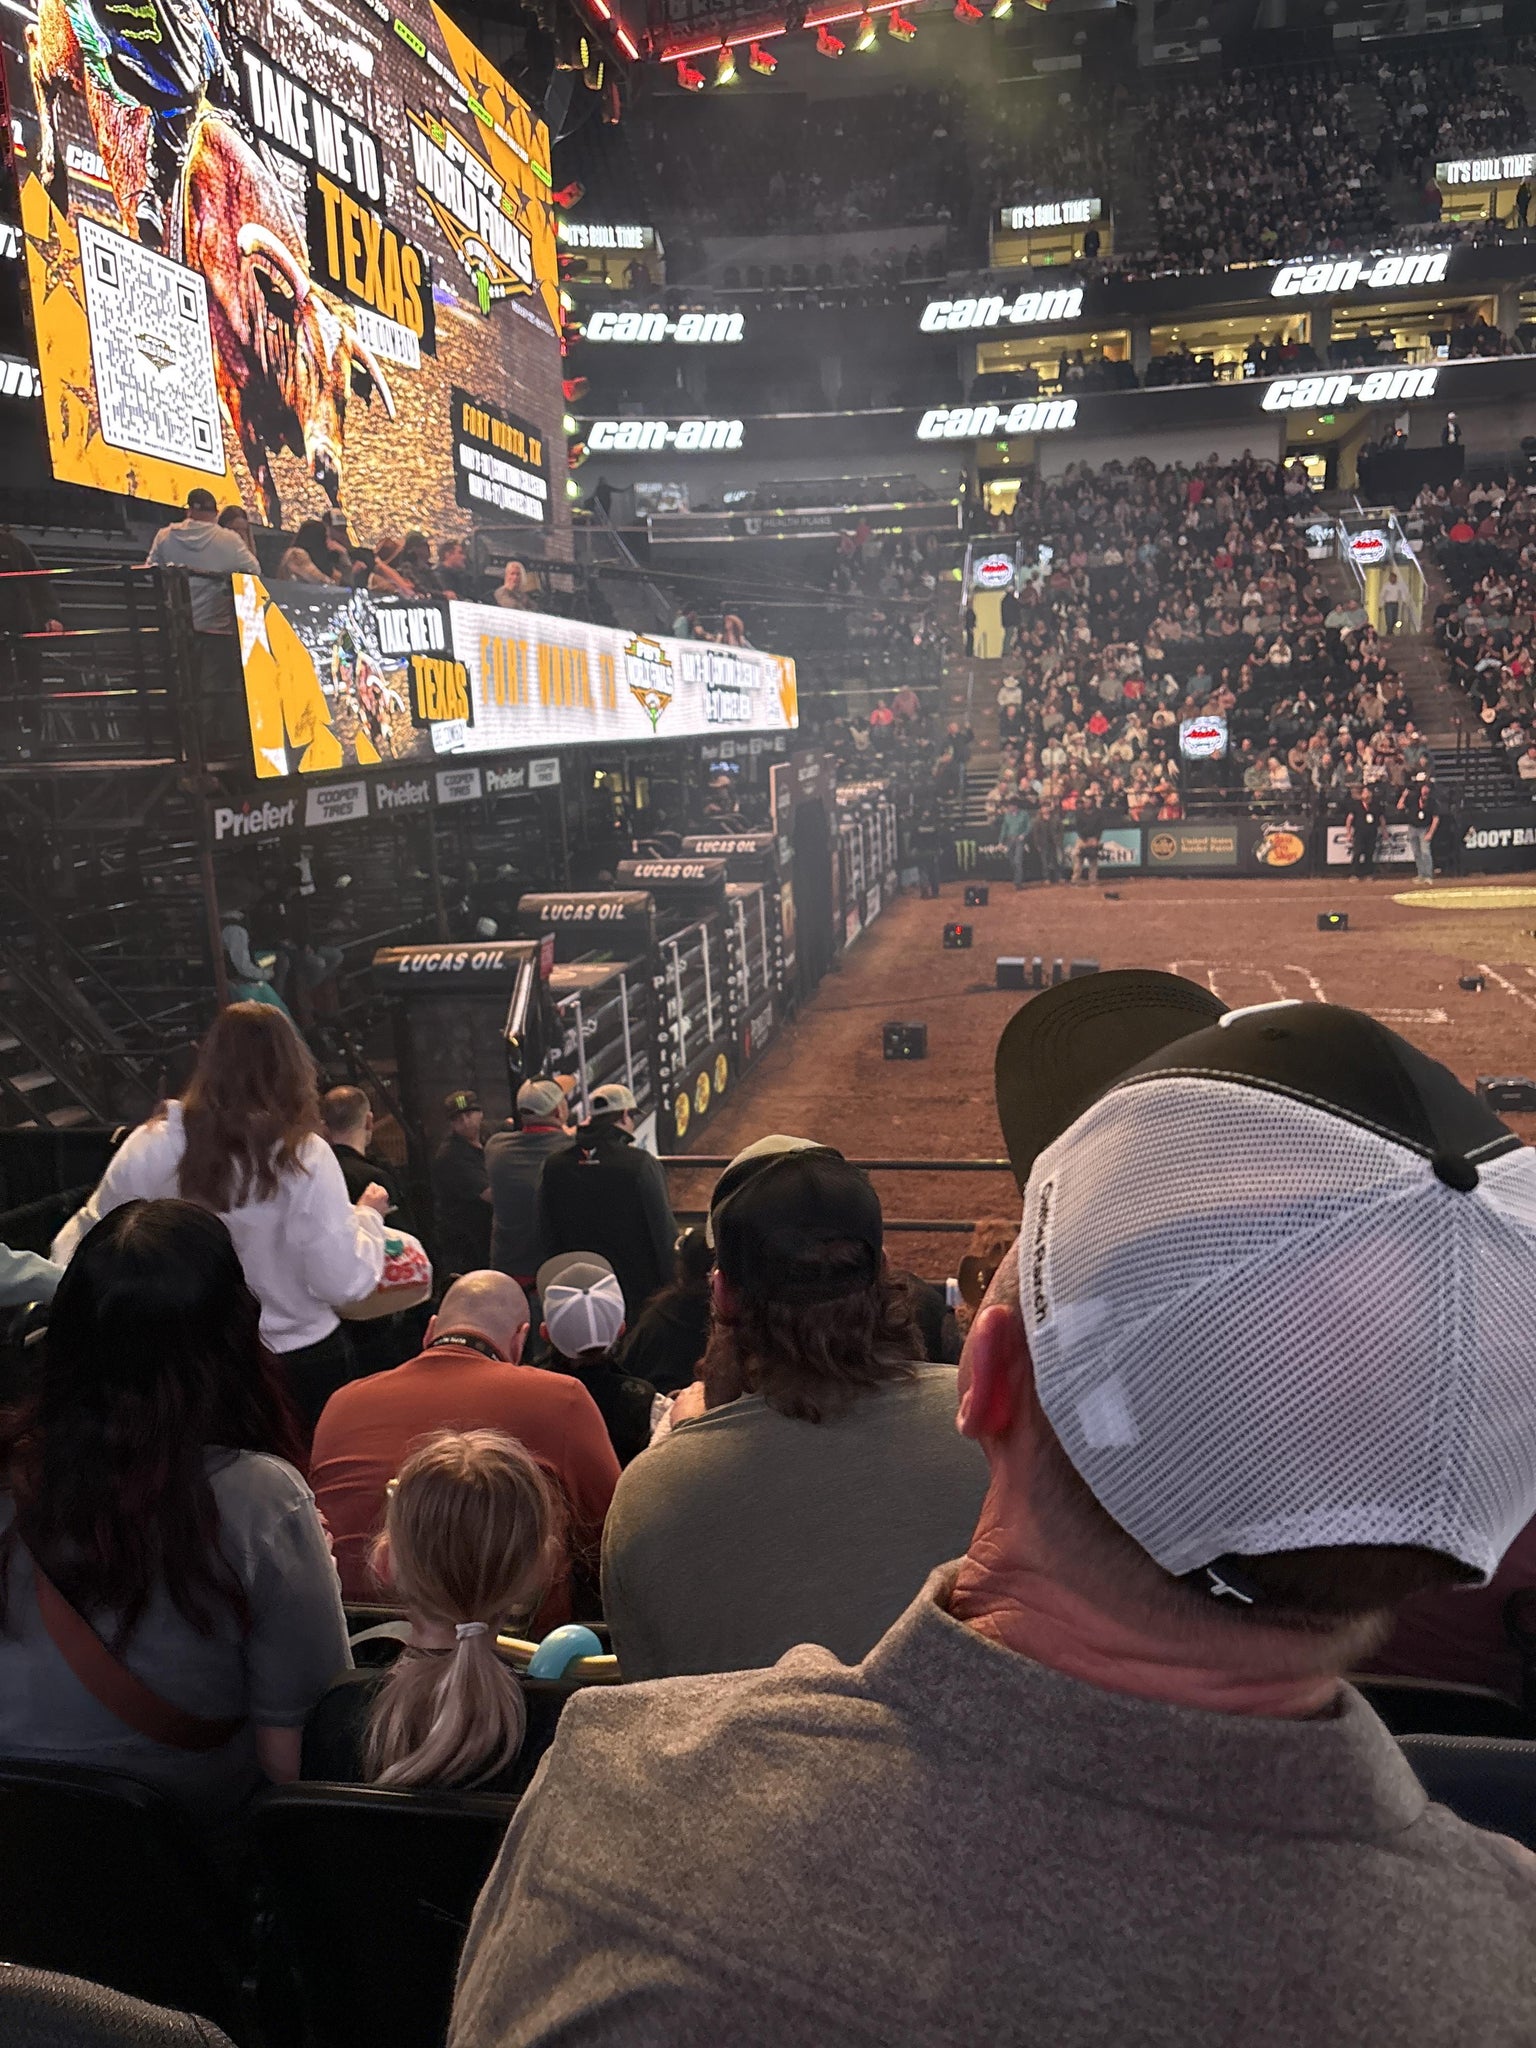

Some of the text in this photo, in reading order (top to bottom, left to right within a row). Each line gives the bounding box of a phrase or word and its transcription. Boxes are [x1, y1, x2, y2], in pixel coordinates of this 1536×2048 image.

[243, 50, 380, 201] TAKE ME TO
[446, 130, 503, 207] PBR
[1447, 156, 1533, 184] IT'S BULL TIME
[409, 121, 478, 232] WORLD
[477, 191, 533, 285] FINALS
[1012, 201, 1091, 230] IT'S BULL TIME
[616, 226, 643, 249] TIME
[316, 172, 424, 338] TEXAS
[462, 402, 490, 441] FORT
[528, 436, 542, 467] TX
[376, 607, 444, 653] TAKE ME TO
[480, 633, 528, 706] FORT
[598, 653, 617, 711] TX
[411, 654, 469, 721] TEXAS
[444, 772, 475, 786] COOPER
[485, 766, 525, 792] Priefert
[316, 787, 360, 806] COOPER
[375, 779, 431, 810] Priefert
[214, 799, 297, 841] Priefert
[323, 801, 354, 819] TIRES
[695, 841, 757, 853] LUCAS OIL
[1512, 827, 1536, 847] BA
[634, 864, 705, 878] LUCAS OIL
[541, 903, 626, 921] LUCAS OIL
[398, 950, 504, 974] LUCAS OIL
[653, 975, 672, 1111] Priefert
